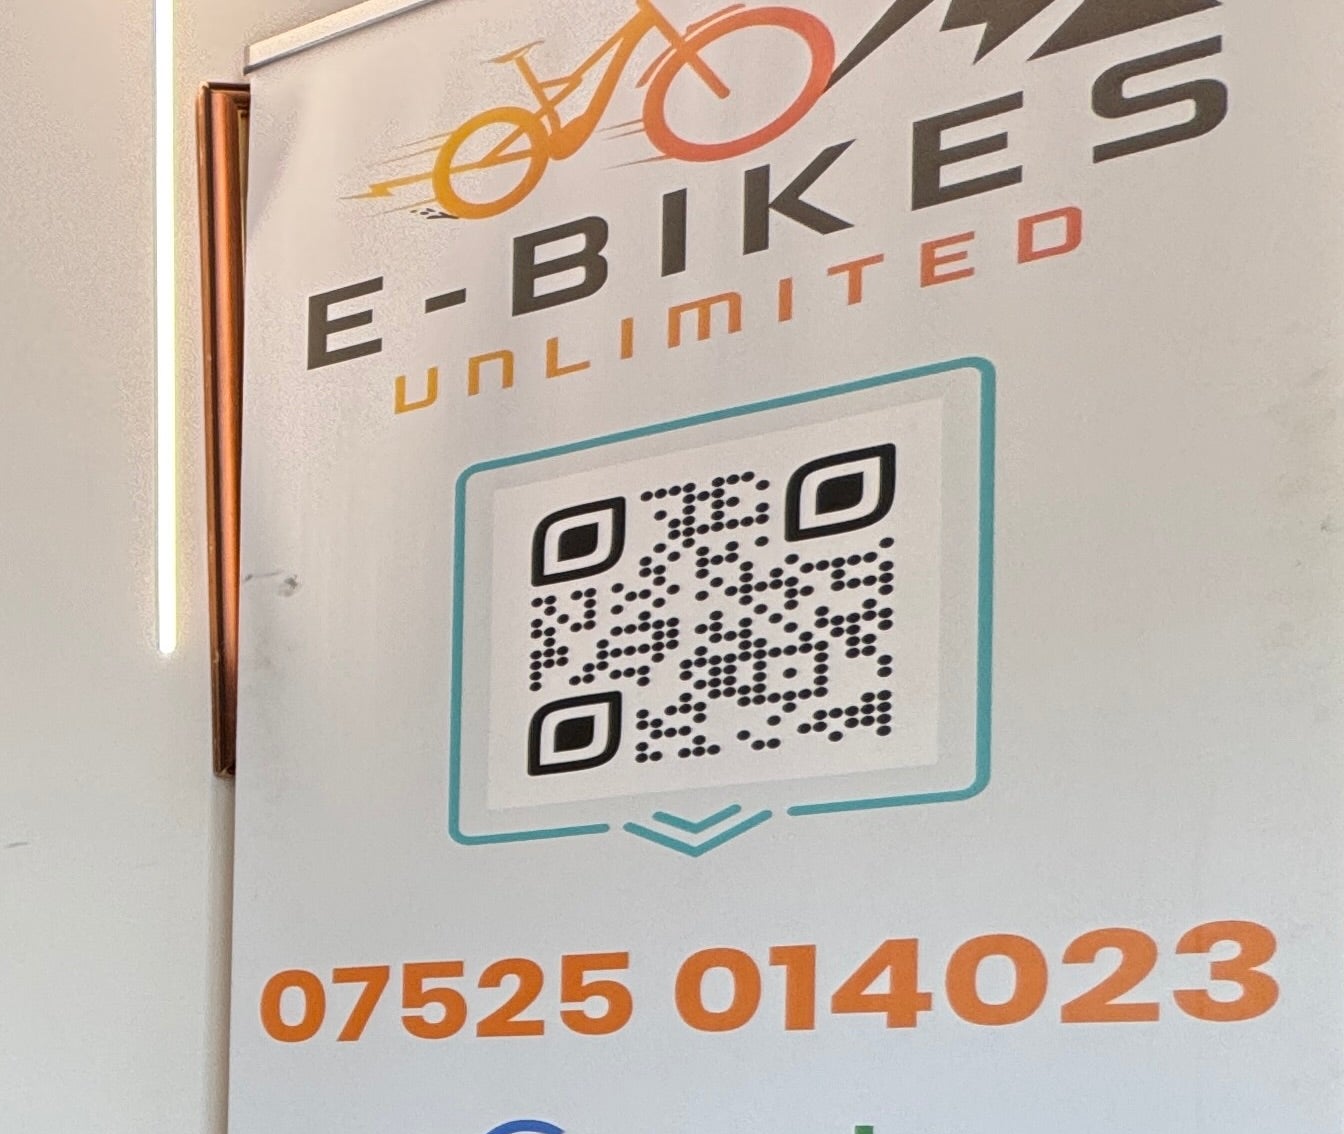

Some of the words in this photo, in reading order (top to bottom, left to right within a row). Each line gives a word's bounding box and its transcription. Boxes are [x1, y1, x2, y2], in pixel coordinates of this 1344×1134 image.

[308, 35, 1227, 369] E-BIKES
[394, 207, 1082, 414] UNLIMITED
[261, 953, 632, 1042] 07525
[676, 921, 1280, 1031] 014023
